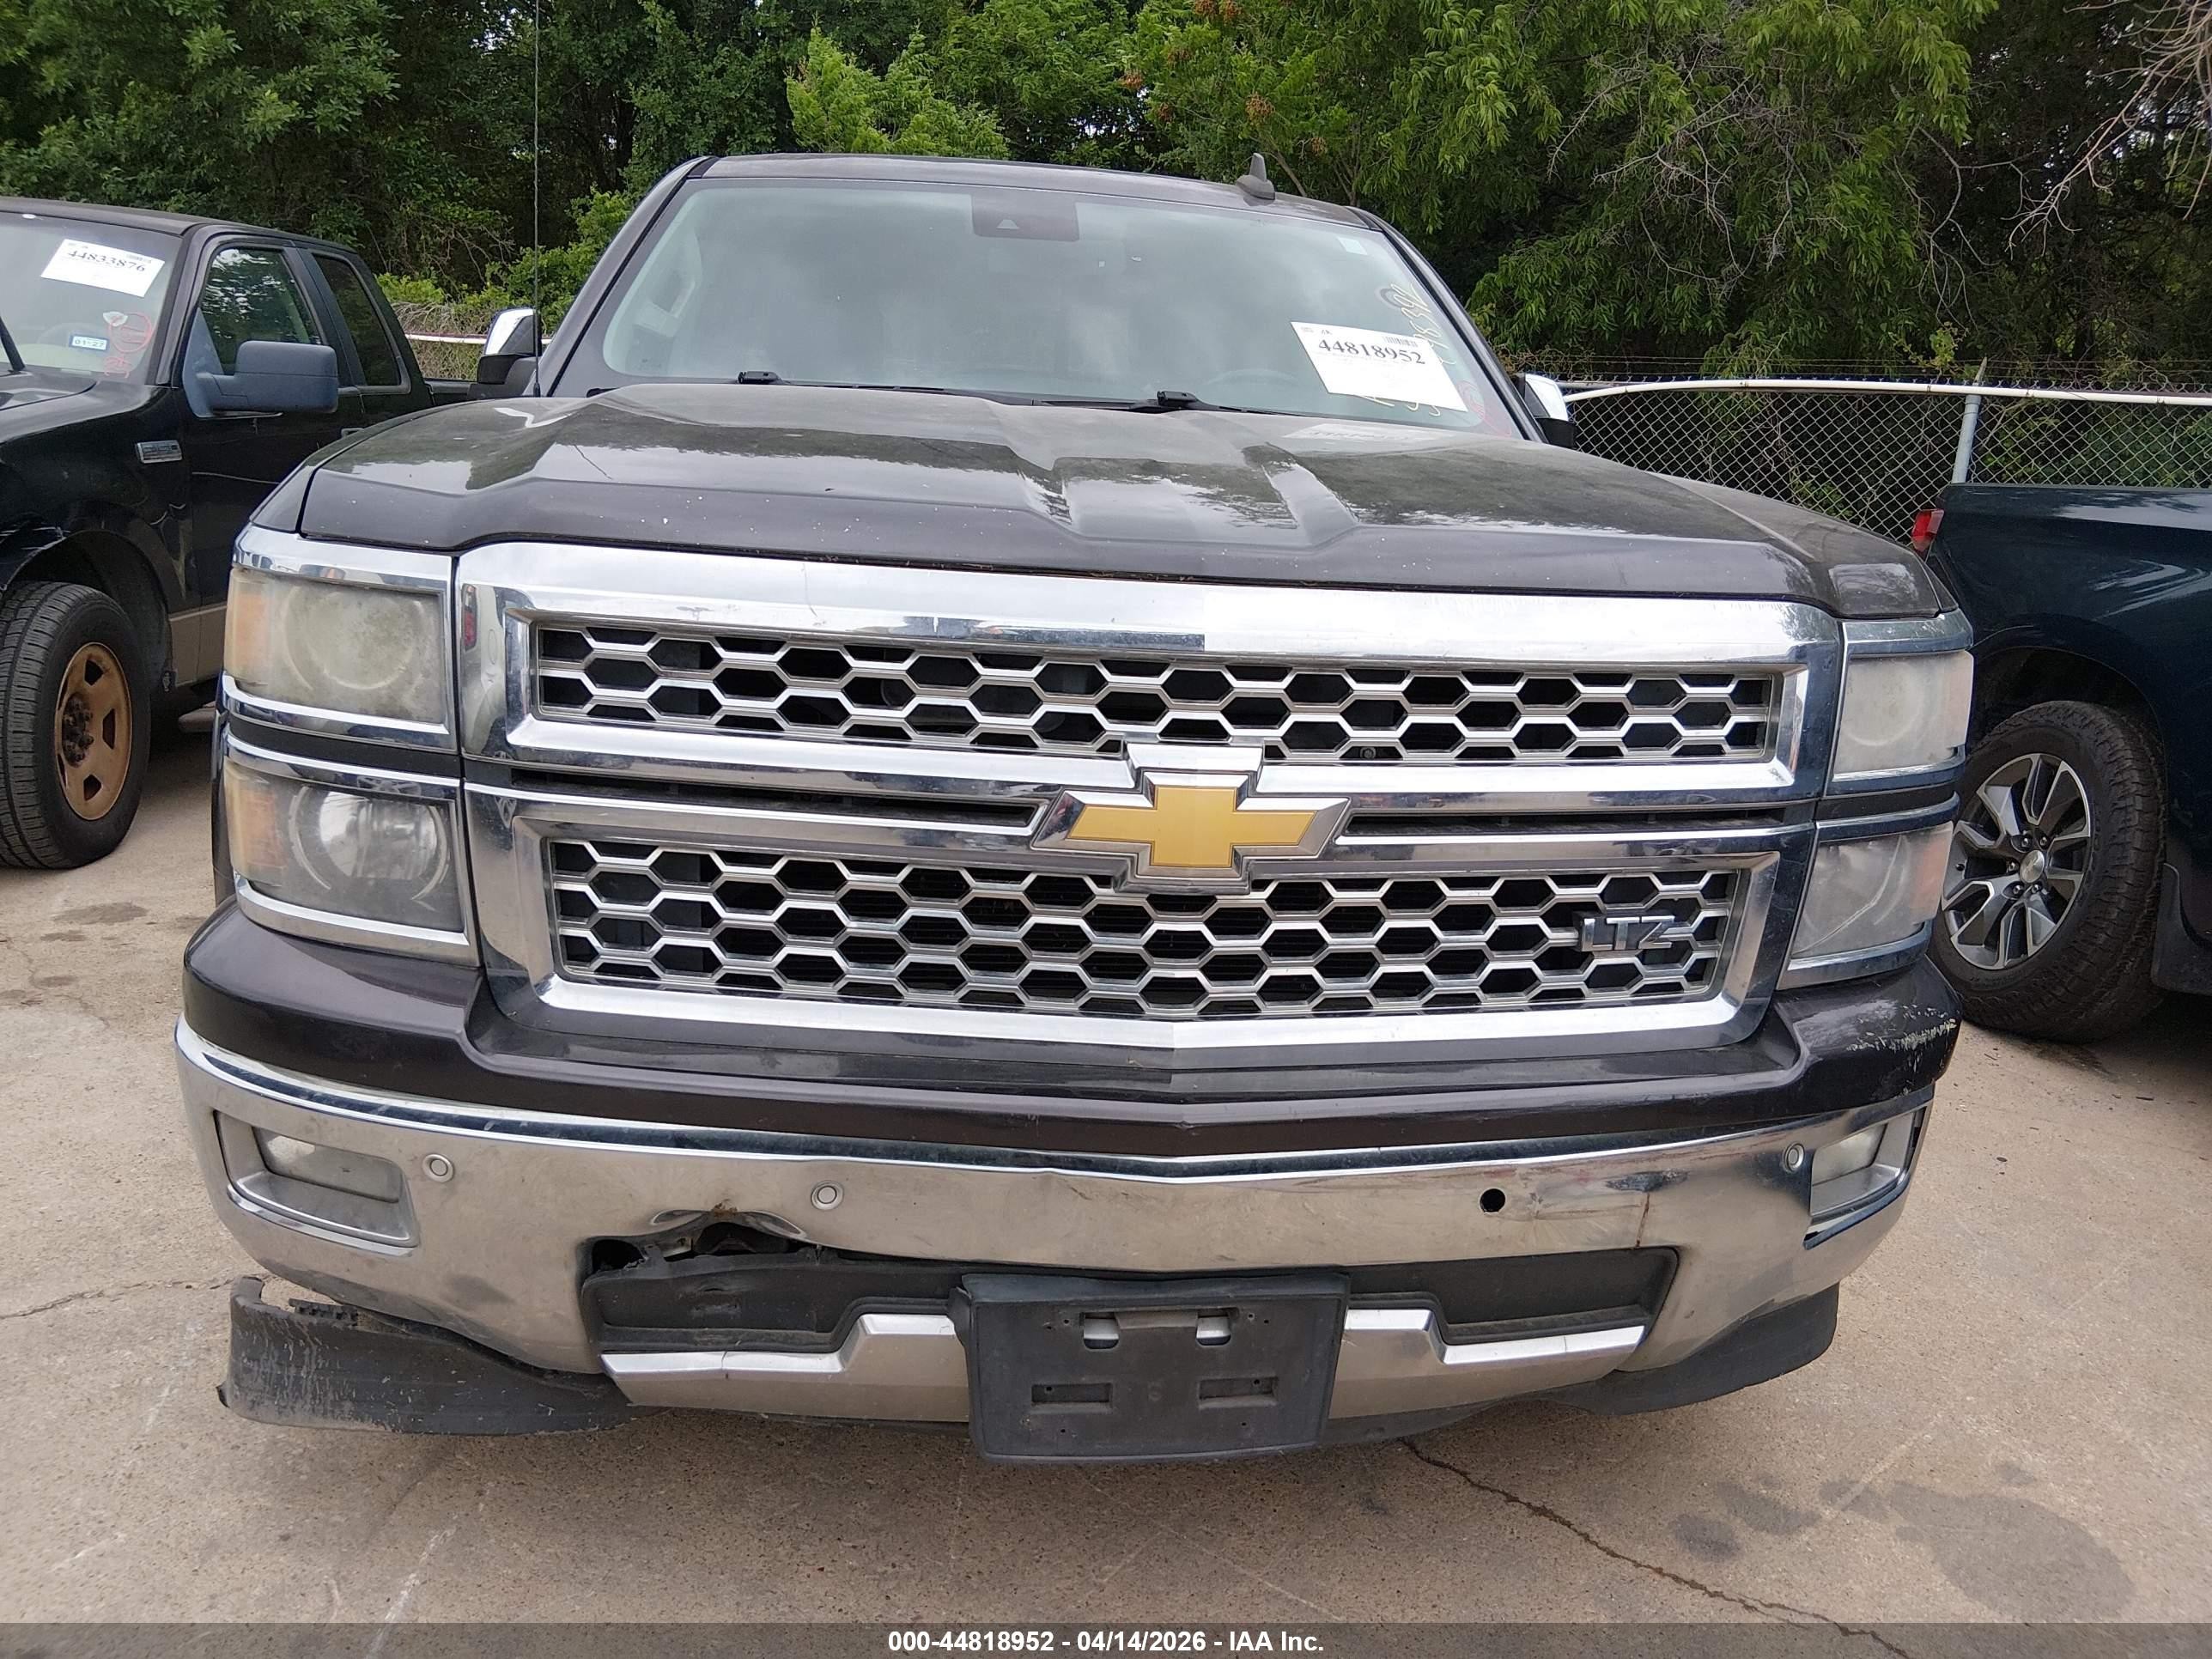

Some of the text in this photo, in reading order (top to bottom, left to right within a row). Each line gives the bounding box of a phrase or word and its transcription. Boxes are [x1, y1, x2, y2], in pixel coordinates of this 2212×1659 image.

[67, 250, 145, 272] 44833876
[1318, 338, 1425, 365] 44818952
[1581, 915, 1674, 952] LTZ
